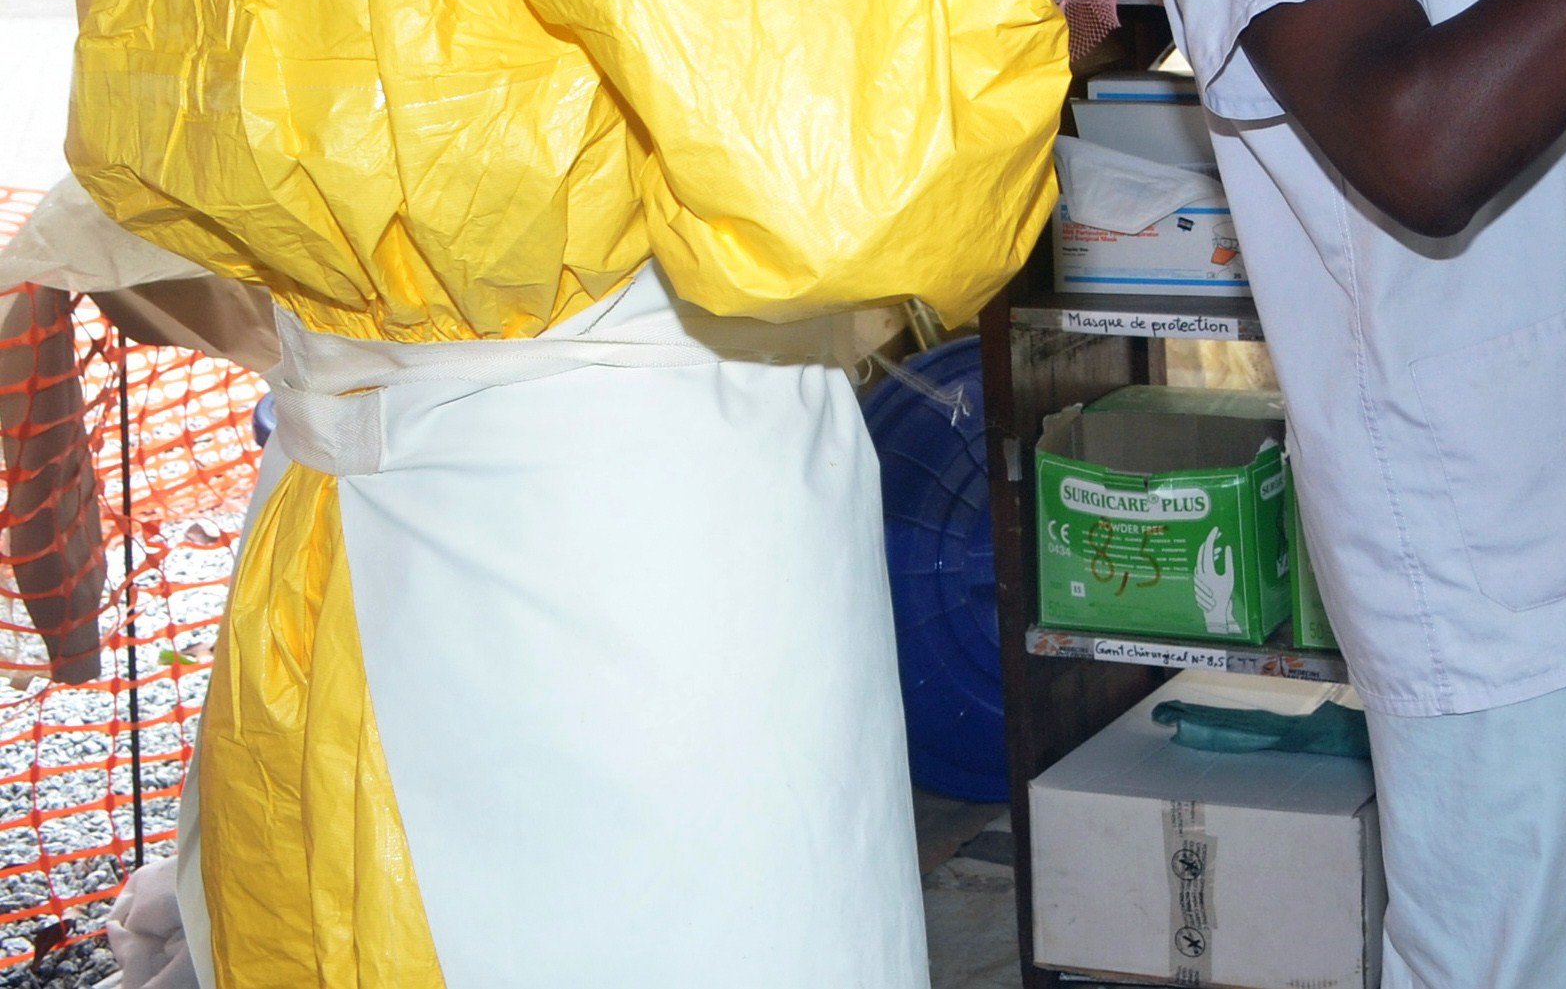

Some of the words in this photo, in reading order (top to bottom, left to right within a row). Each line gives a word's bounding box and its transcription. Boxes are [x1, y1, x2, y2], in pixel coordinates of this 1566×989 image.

[1068, 312, 1125, 333] Masque
[1130, 316, 1146, 330] de
[1152, 315, 1229, 336] protection
[1162, 495, 1206, 512] PLUS
[1095, 639, 1124, 656] Gant
[1126, 644, 1189, 665] chirurgical
